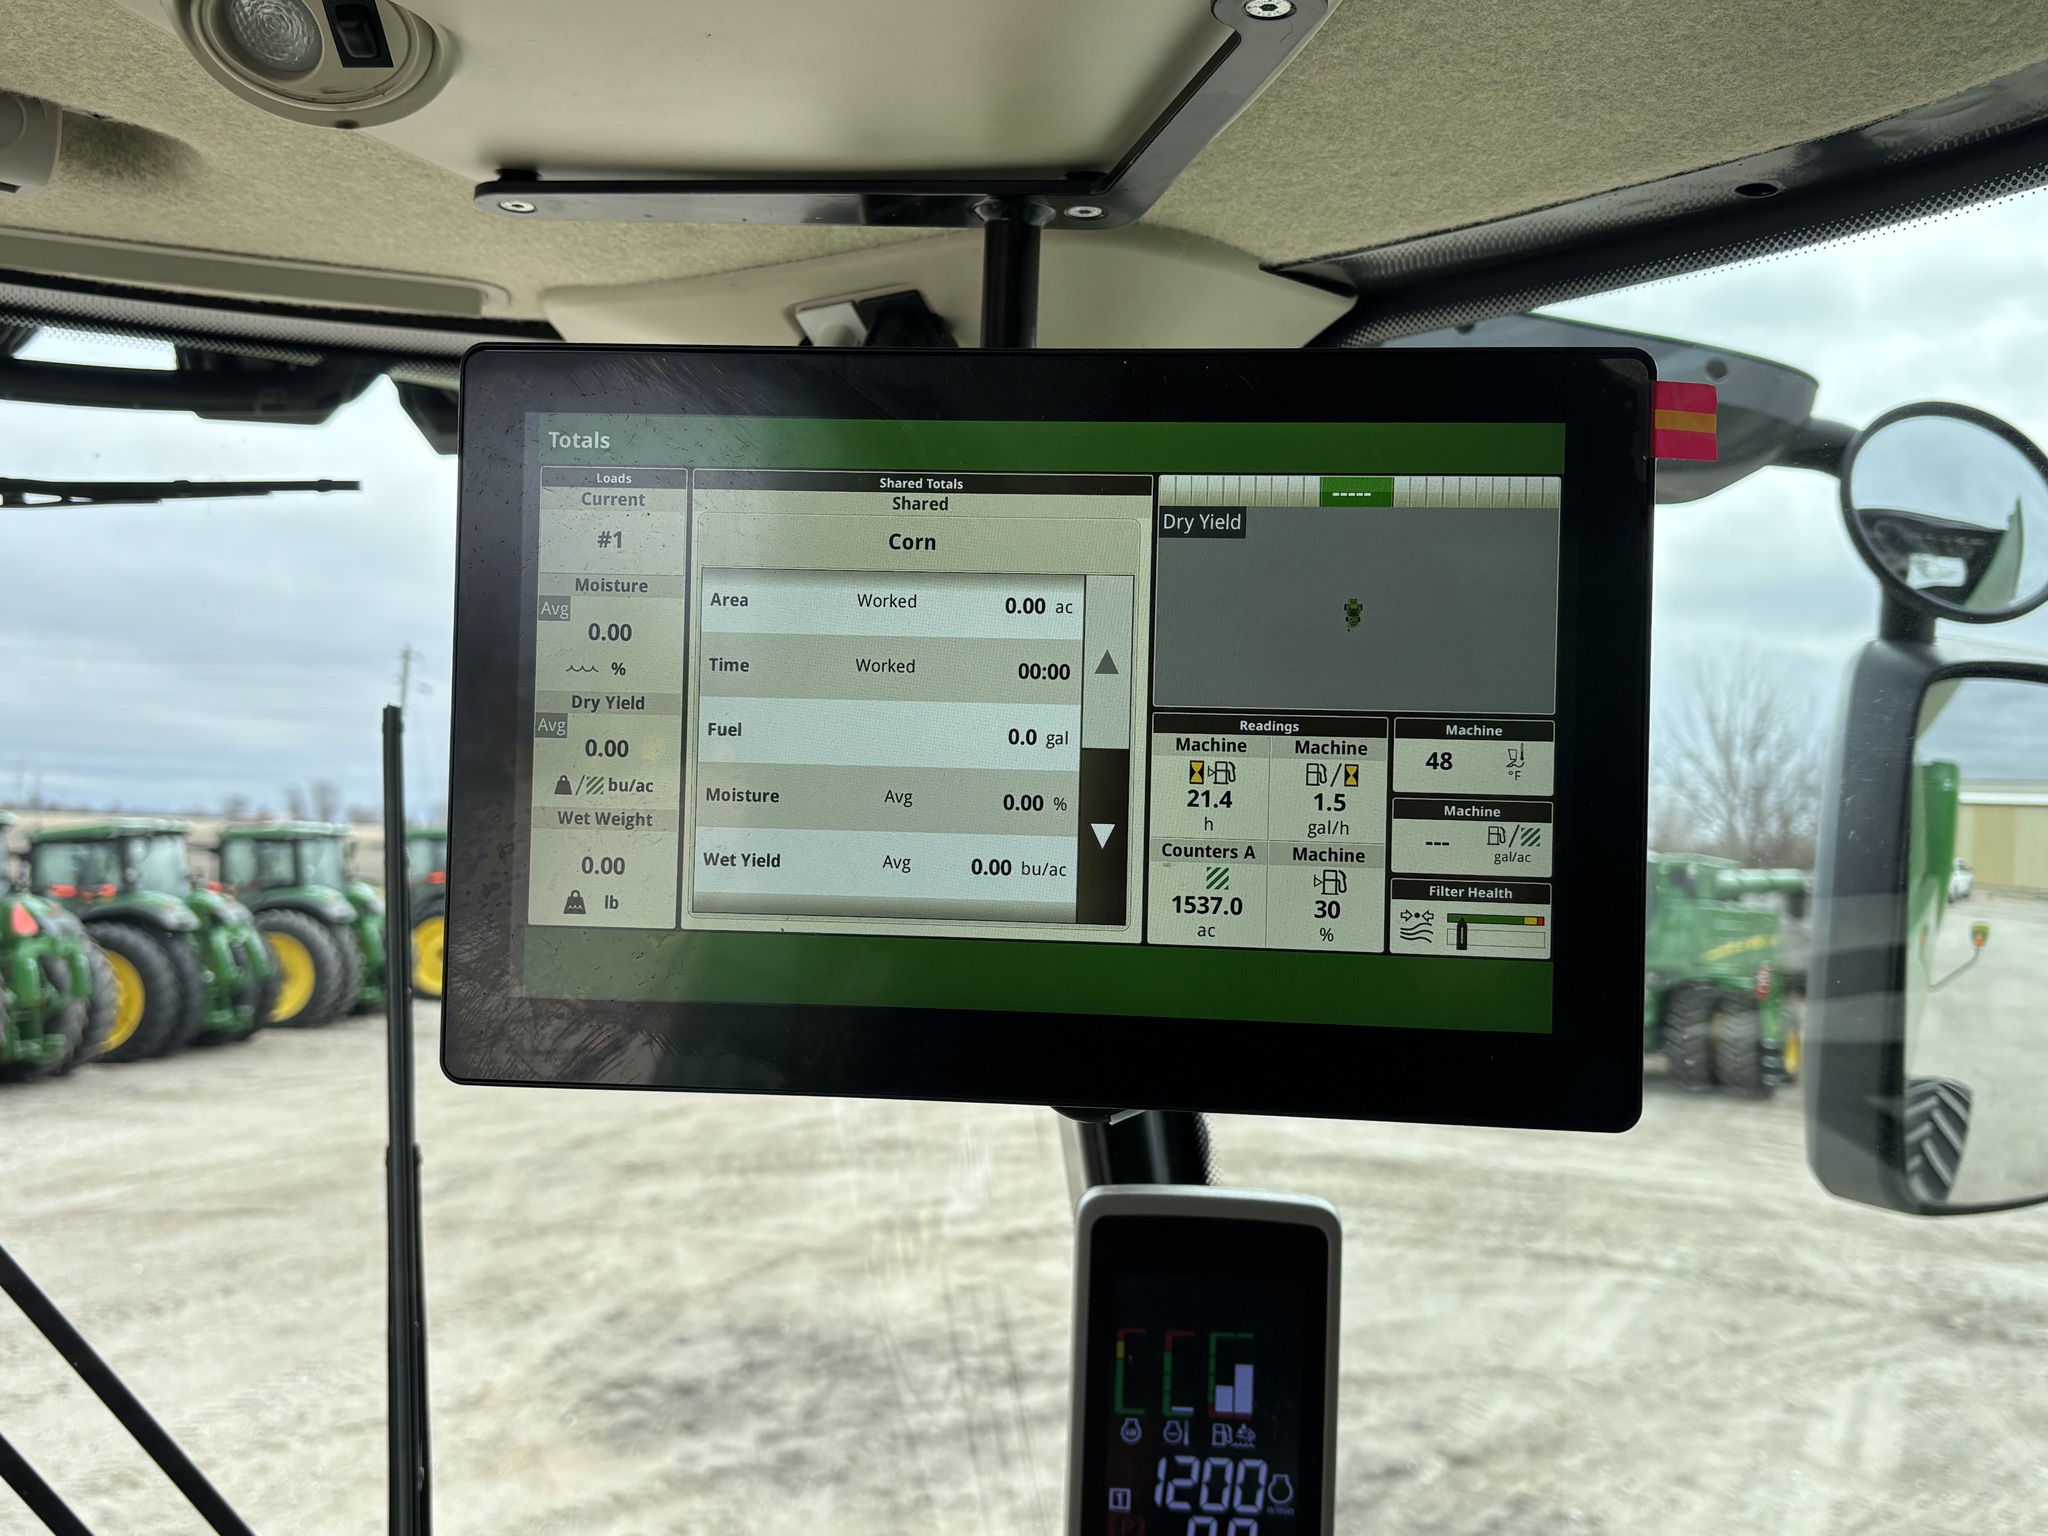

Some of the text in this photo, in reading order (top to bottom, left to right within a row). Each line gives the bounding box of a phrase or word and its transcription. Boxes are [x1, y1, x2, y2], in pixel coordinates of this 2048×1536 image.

[549, 432, 610, 449] Totals
[596, 473, 632, 484] Loads
[879, 478, 963, 490] Shared Totals
[581, 492, 646, 507] Current
[892, 496, 948, 511] Shared
[1163, 513, 1241, 534] Dry Yield
[598, 531, 622, 549] #1
[889, 533, 936, 551] Corn
[575, 578, 648, 593] Moisture
[541, 601, 569, 619] Avg
[711, 593, 1073, 615] Area Worked 0.00 ac
[588, 623, 632, 641] 0.00
[611, 662, 626, 676] %
[709, 658, 1070, 680] Time Worked 00:00
[571, 695, 645, 712] Dry Yield
[537, 718, 566, 735] Avg
[1240, 721, 1299, 733] Readings
[1446, 725, 1502, 736] Machine
[708, 723, 1068, 749] Fuel 0.0 gal
[585, 739, 629, 757] 0.00
[1176, 738, 1247, 752] Machine
[1295, 740, 1368, 755] Machine
[1426, 752, 1453, 770] 48
[1508, 771, 1521, 781] °F
[608, 778, 653, 793] bu/ac
[706, 788, 1067, 811] Moisture Avg 0.00 %
[1187, 790, 1232, 808] 21.4
[1314, 793, 1346, 811] 1.5
[1444, 805, 1500, 817] Machine
[558, 811, 653, 830] Wet Weight
[1204, 817, 1213, 831] h
[1308, 820, 1349, 838] gal/h
[1162, 843, 1255, 859] Counters A
[1293, 847, 1365, 862] Machine
[1494, 852, 1531, 864] gal/ac
[581, 857, 625, 875] 0.00
[704, 853, 1066, 877] Wet Yield Avg 0.00 bu/ac
[1429, 886, 1513, 899] Filter Health
[604, 895, 619, 909] lb
[1172, 896, 1243, 915] 1537.0
[1314, 900, 1340, 919] 30
[1197, 926, 1215, 937] ac
[1320, 928, 1334, 941] %
[1154, 1455, 1268, 1514] 1200
